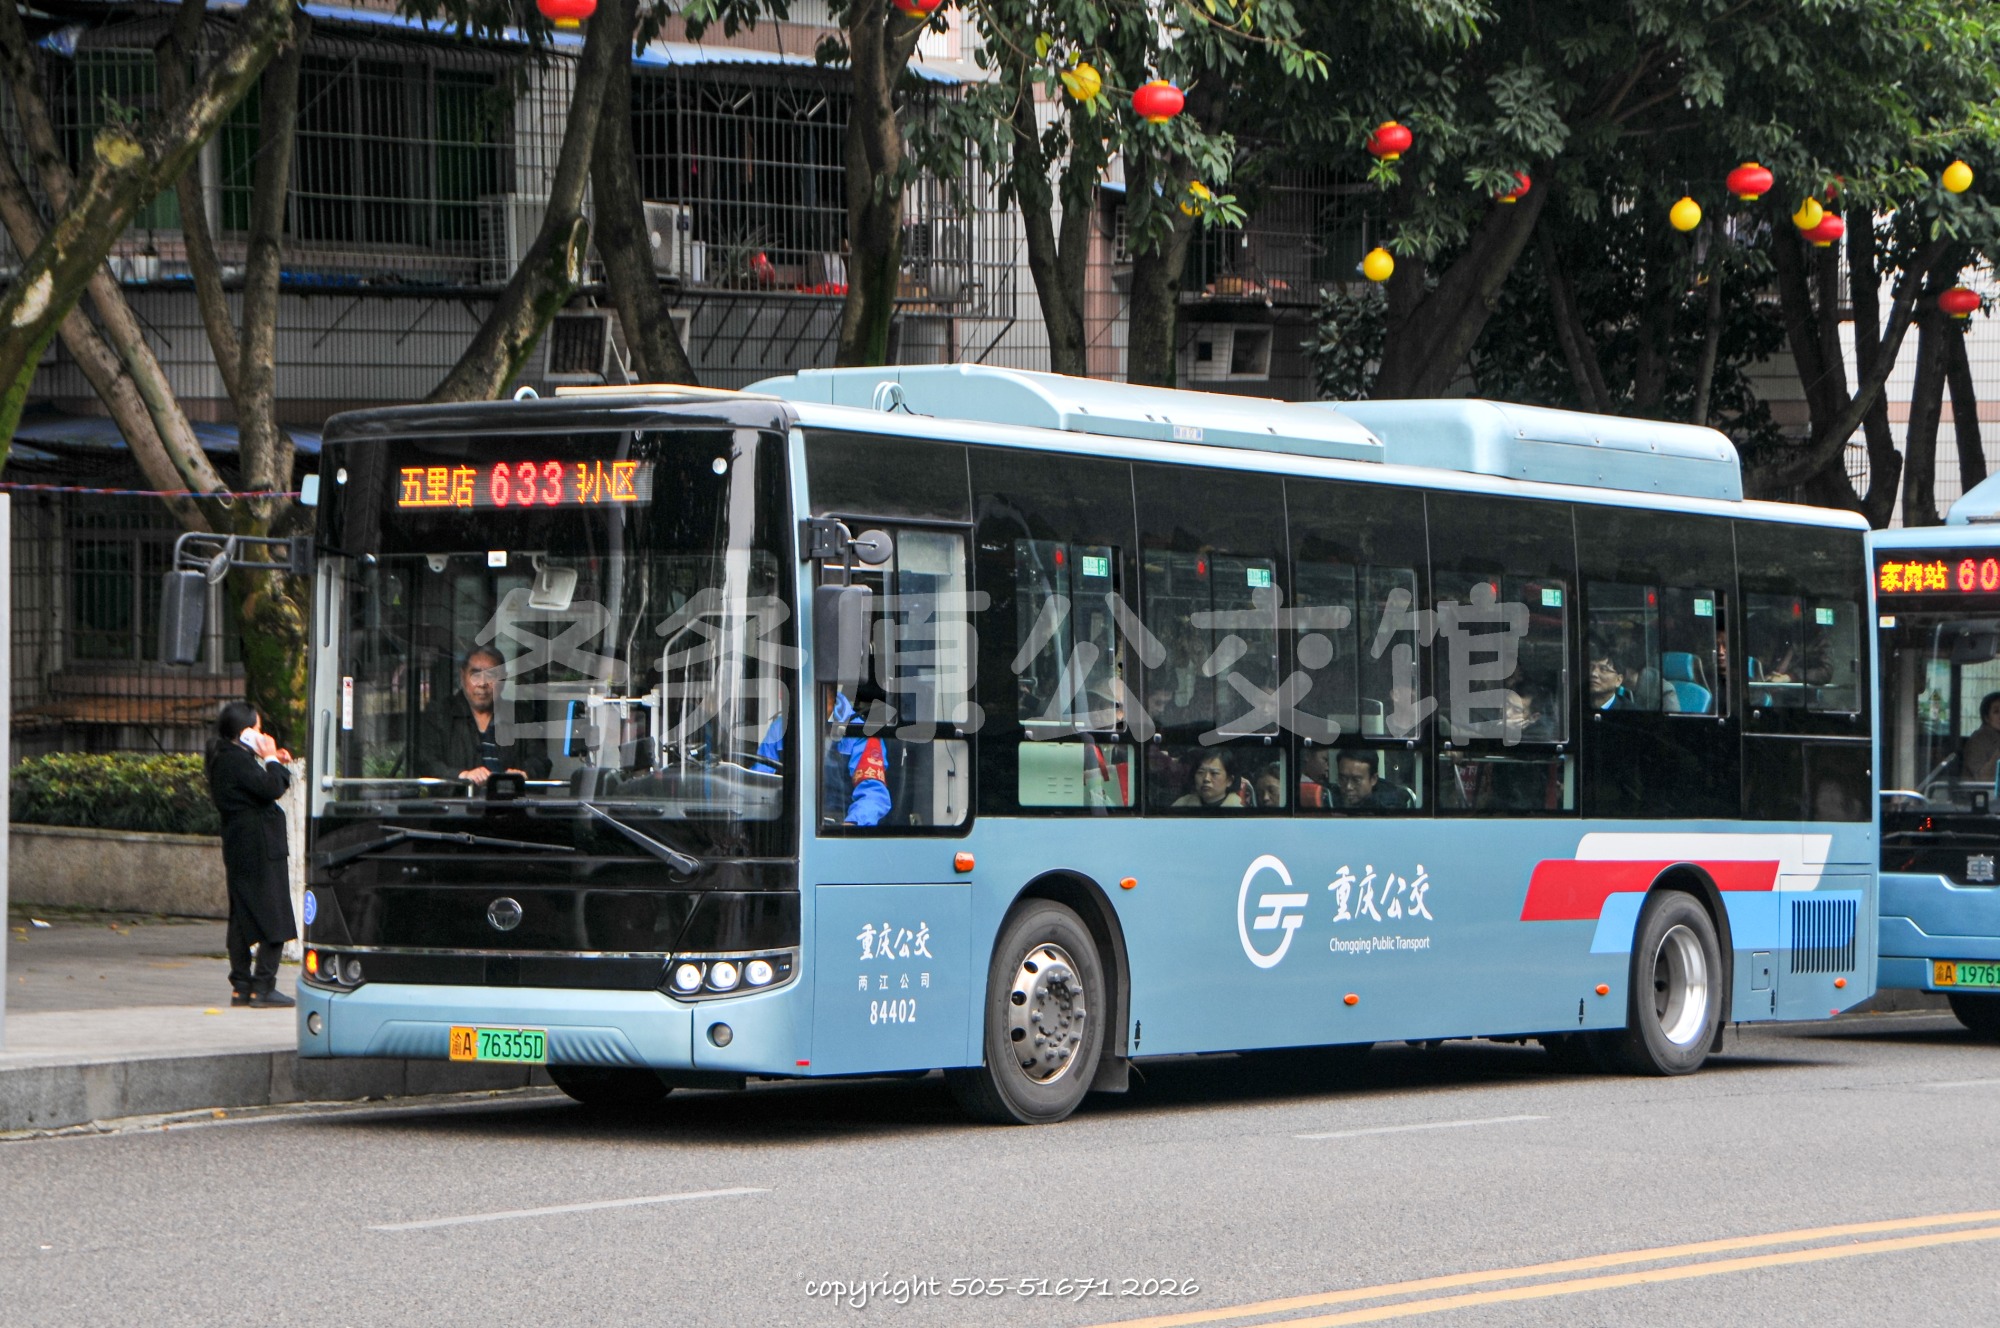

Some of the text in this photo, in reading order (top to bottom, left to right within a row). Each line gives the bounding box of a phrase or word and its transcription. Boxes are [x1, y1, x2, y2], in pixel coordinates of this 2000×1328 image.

[398, 465, 477, 507] 五里店
[490, 461, 563, 506] 633
[1327, 864, 1434, 922] 重庆公交
[856, 922, 933, 961] 重庆公交
[1329, 936, 1429, 953] Chongqing Public Transport
[858, 972, 930, 991] 两江公司
[869, 998, 917, 1025] 84402
[481, 1032, 544, 1059] 76355D
